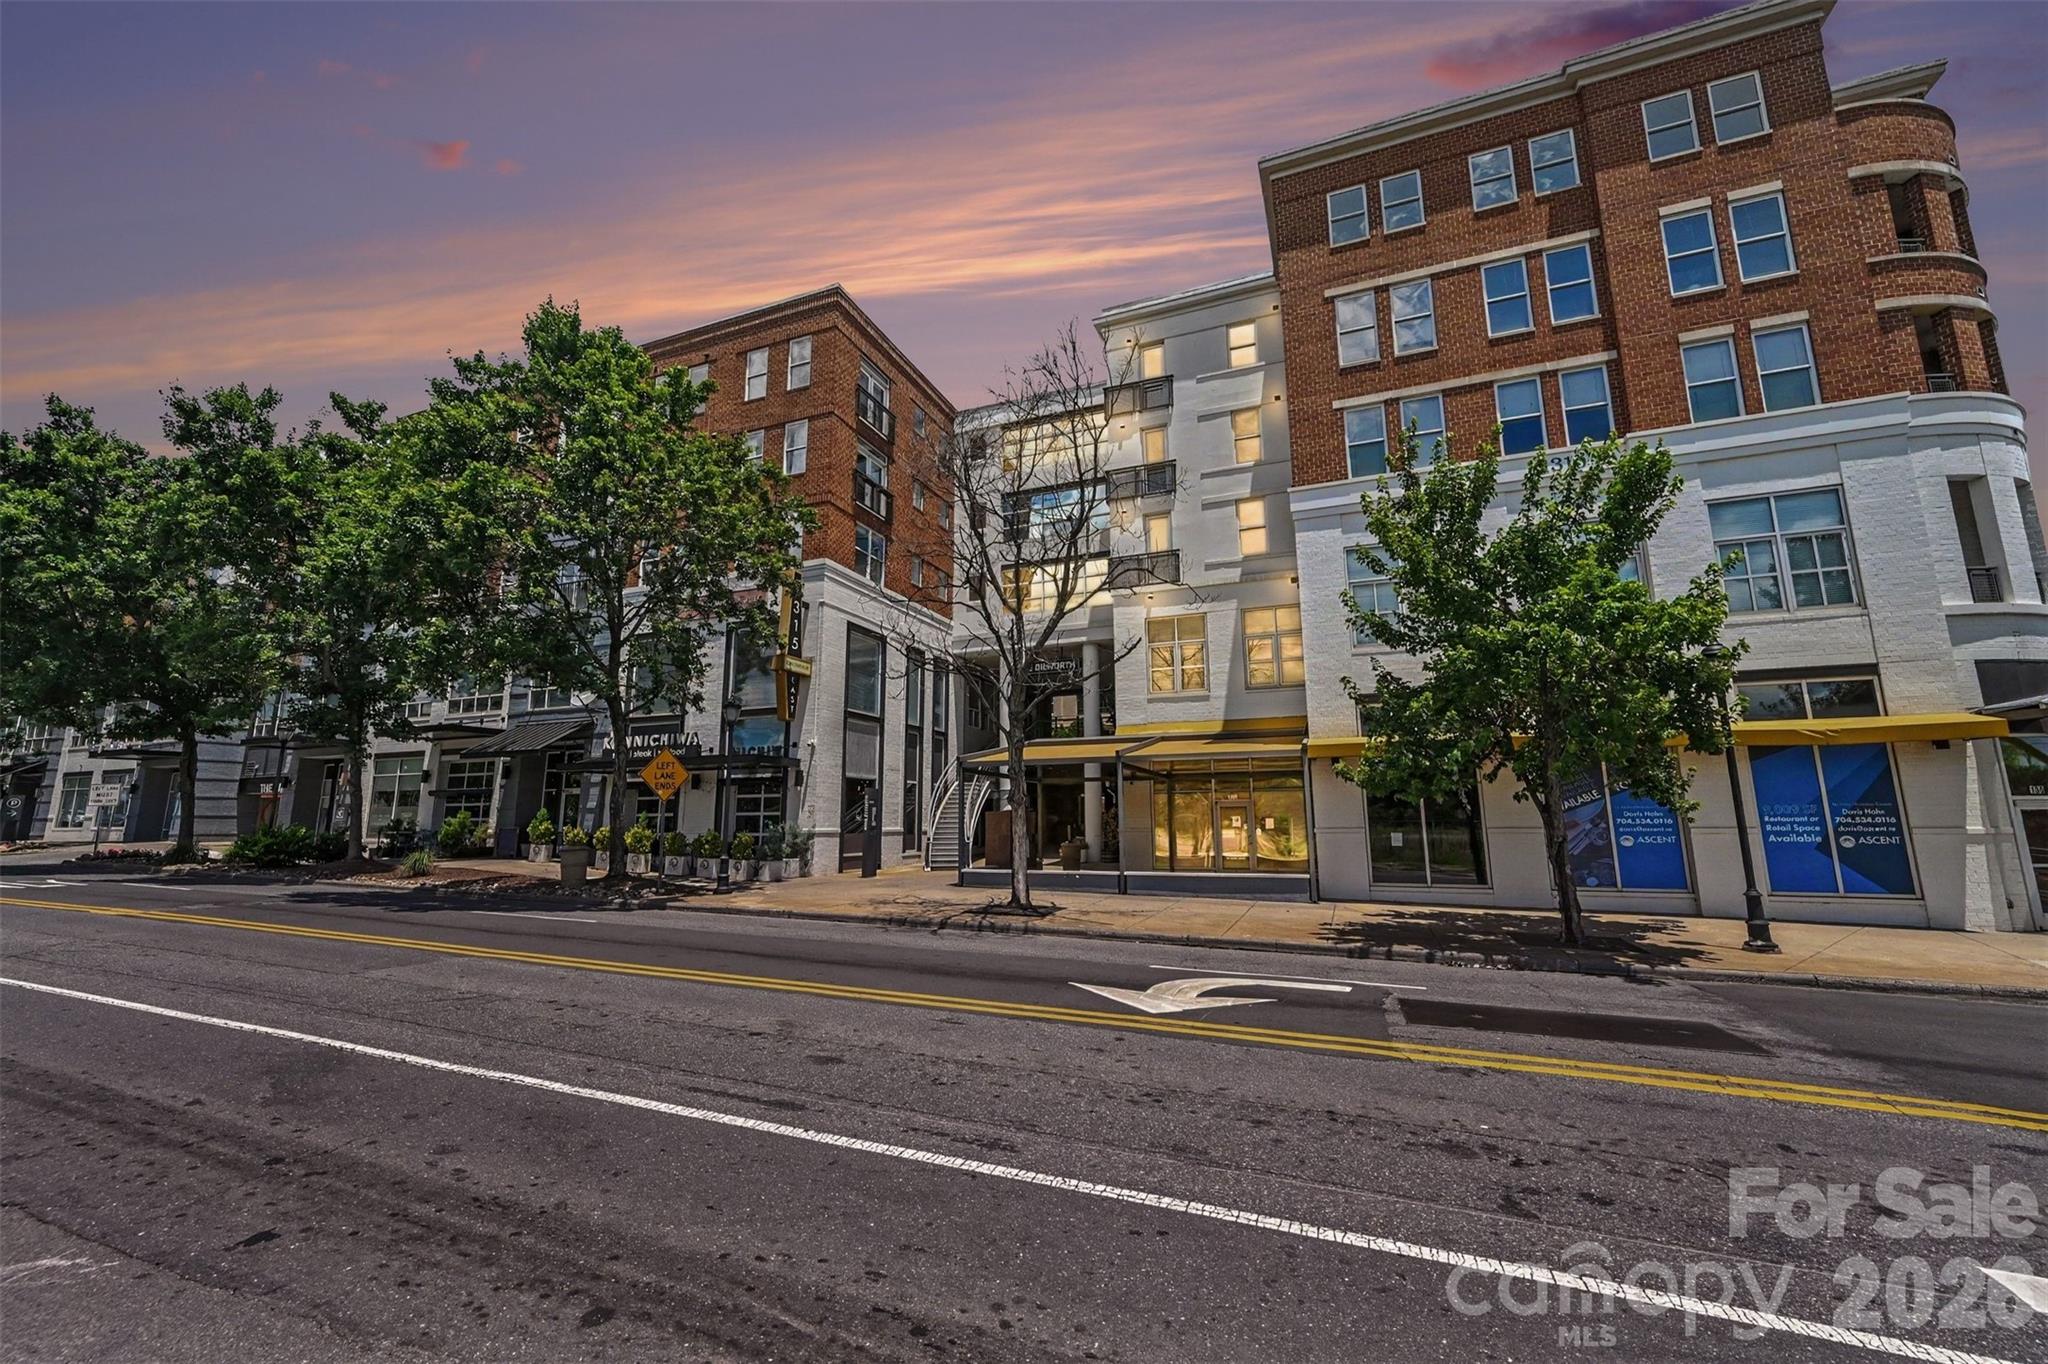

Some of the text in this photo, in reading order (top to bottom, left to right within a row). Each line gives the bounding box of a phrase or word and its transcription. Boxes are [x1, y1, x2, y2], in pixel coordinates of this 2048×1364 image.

[791, 600, 800, 650] 315
[657, 761, 676, 770] LEFT
[654, 772, 676, 780] LANE
[655, 782, 677, 790] ENDS
[1793, 824, 1821, 833] Space
[1637, 836, 1677, 844] ASCENT
[1768, 834, 1823, 843] Available
[1858, 836, 1902, 844] ASCENT
